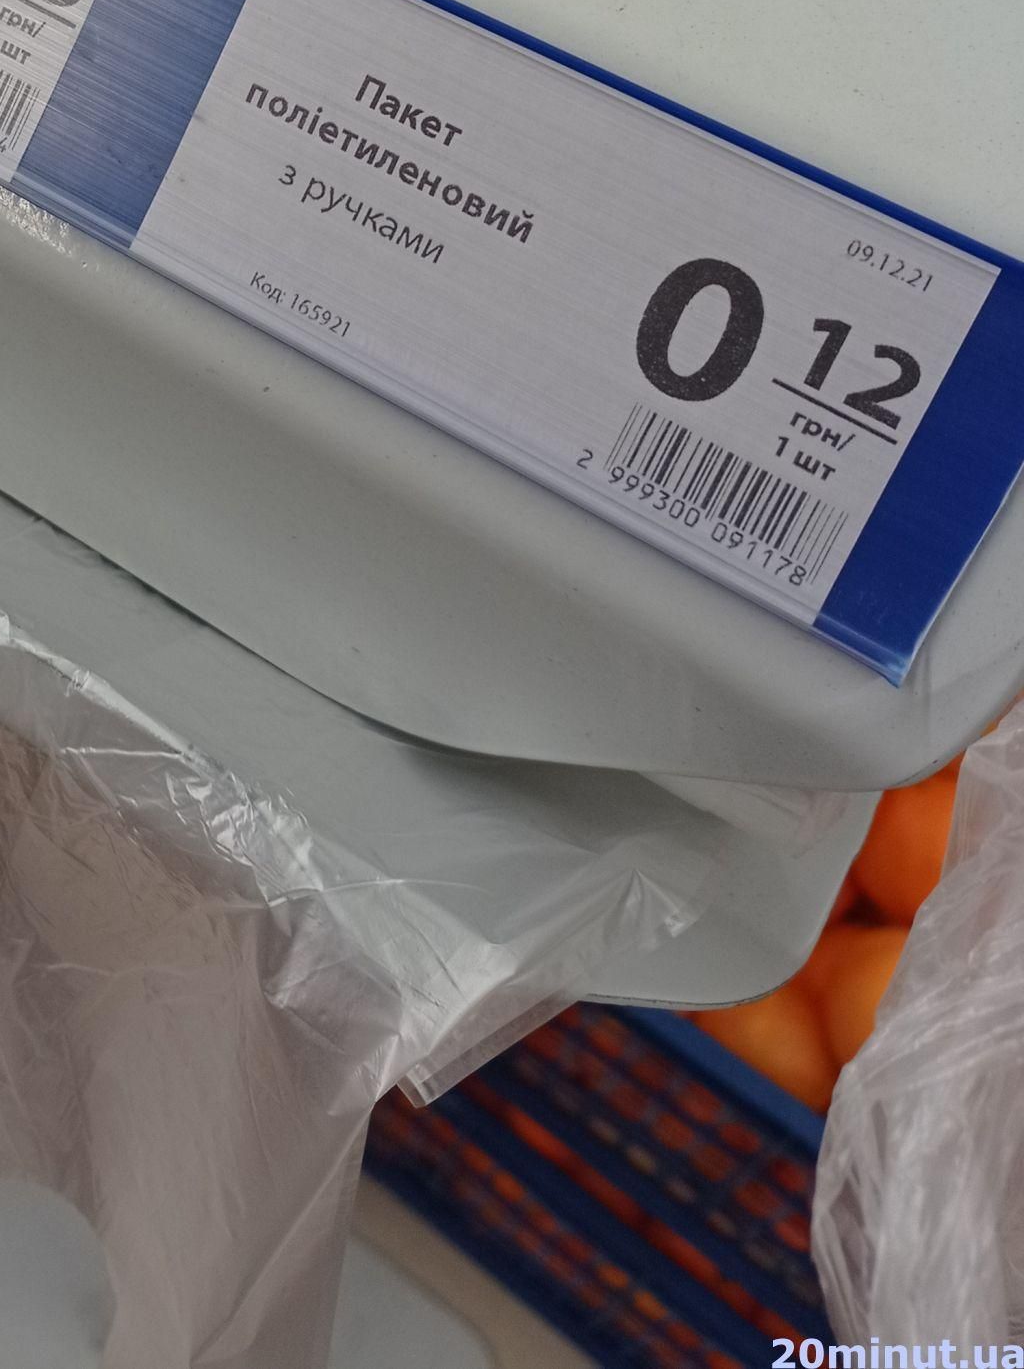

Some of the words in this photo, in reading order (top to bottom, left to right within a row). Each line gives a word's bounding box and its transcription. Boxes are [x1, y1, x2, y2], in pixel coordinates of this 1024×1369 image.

[1, 39, 31, 65] шт
[355, 75, 463, 147] Пакет
[245, 83, 535, 243] поліетиленовий
[278, 165, 297, 186] з
[301, 178, 445, 264] ручками
[847, 239, 933, 292] 09.12.21
[250, 272, 287, 303] Код:
[290, 293, 351, 337] 165921
[636, 258, 764, 401] 0
[804, 318, 921, 430] 12
[775, 436, 788, 457] 1
[793, 452, 836, 481] шт
[789, 411, 856, 451] грн/
[576, 449, 594, 468] 2
[609, 466, 701, 528] 999300
[711, 522, 807, 586] 091178
